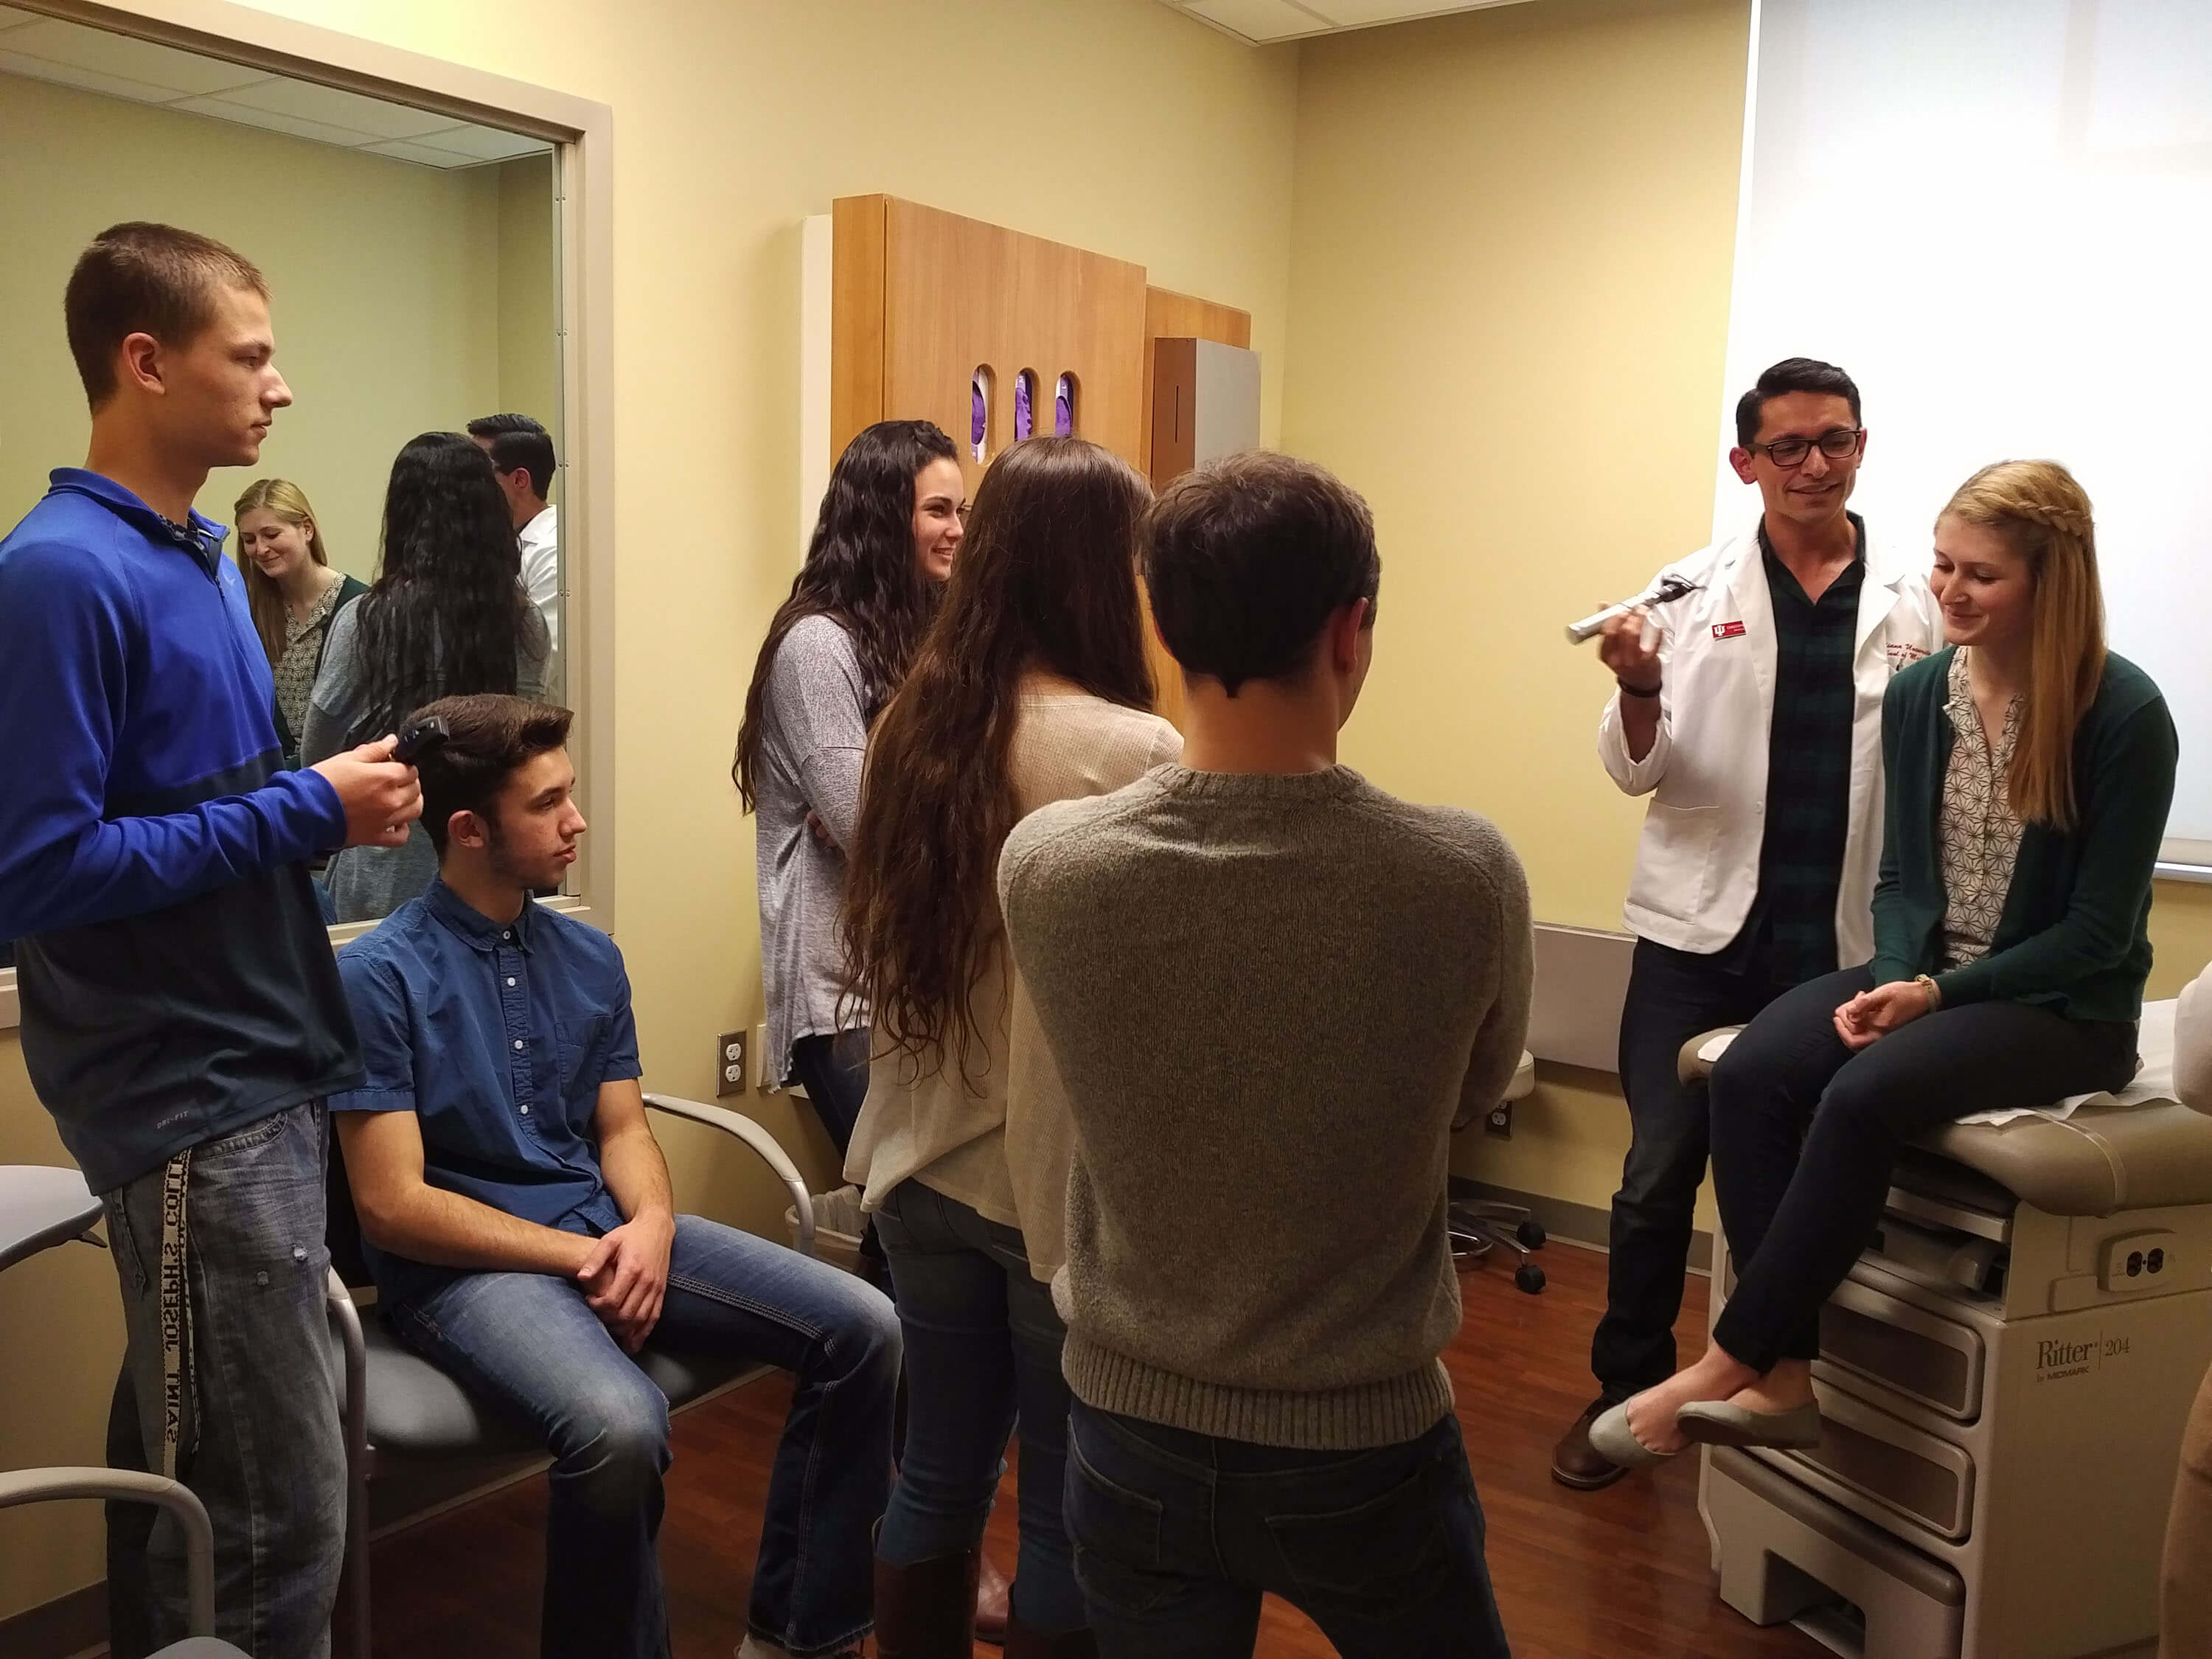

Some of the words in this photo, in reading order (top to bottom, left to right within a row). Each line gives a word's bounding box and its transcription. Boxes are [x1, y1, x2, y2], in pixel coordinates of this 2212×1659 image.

[156, 1110, 189, 1130] DRI-FIT
[2035, 1339, 2093, 1370] Ritter
[2105, 1336, 2130, 1357] 204
[2047, 1365, 2090, 1381] MIDMARK
